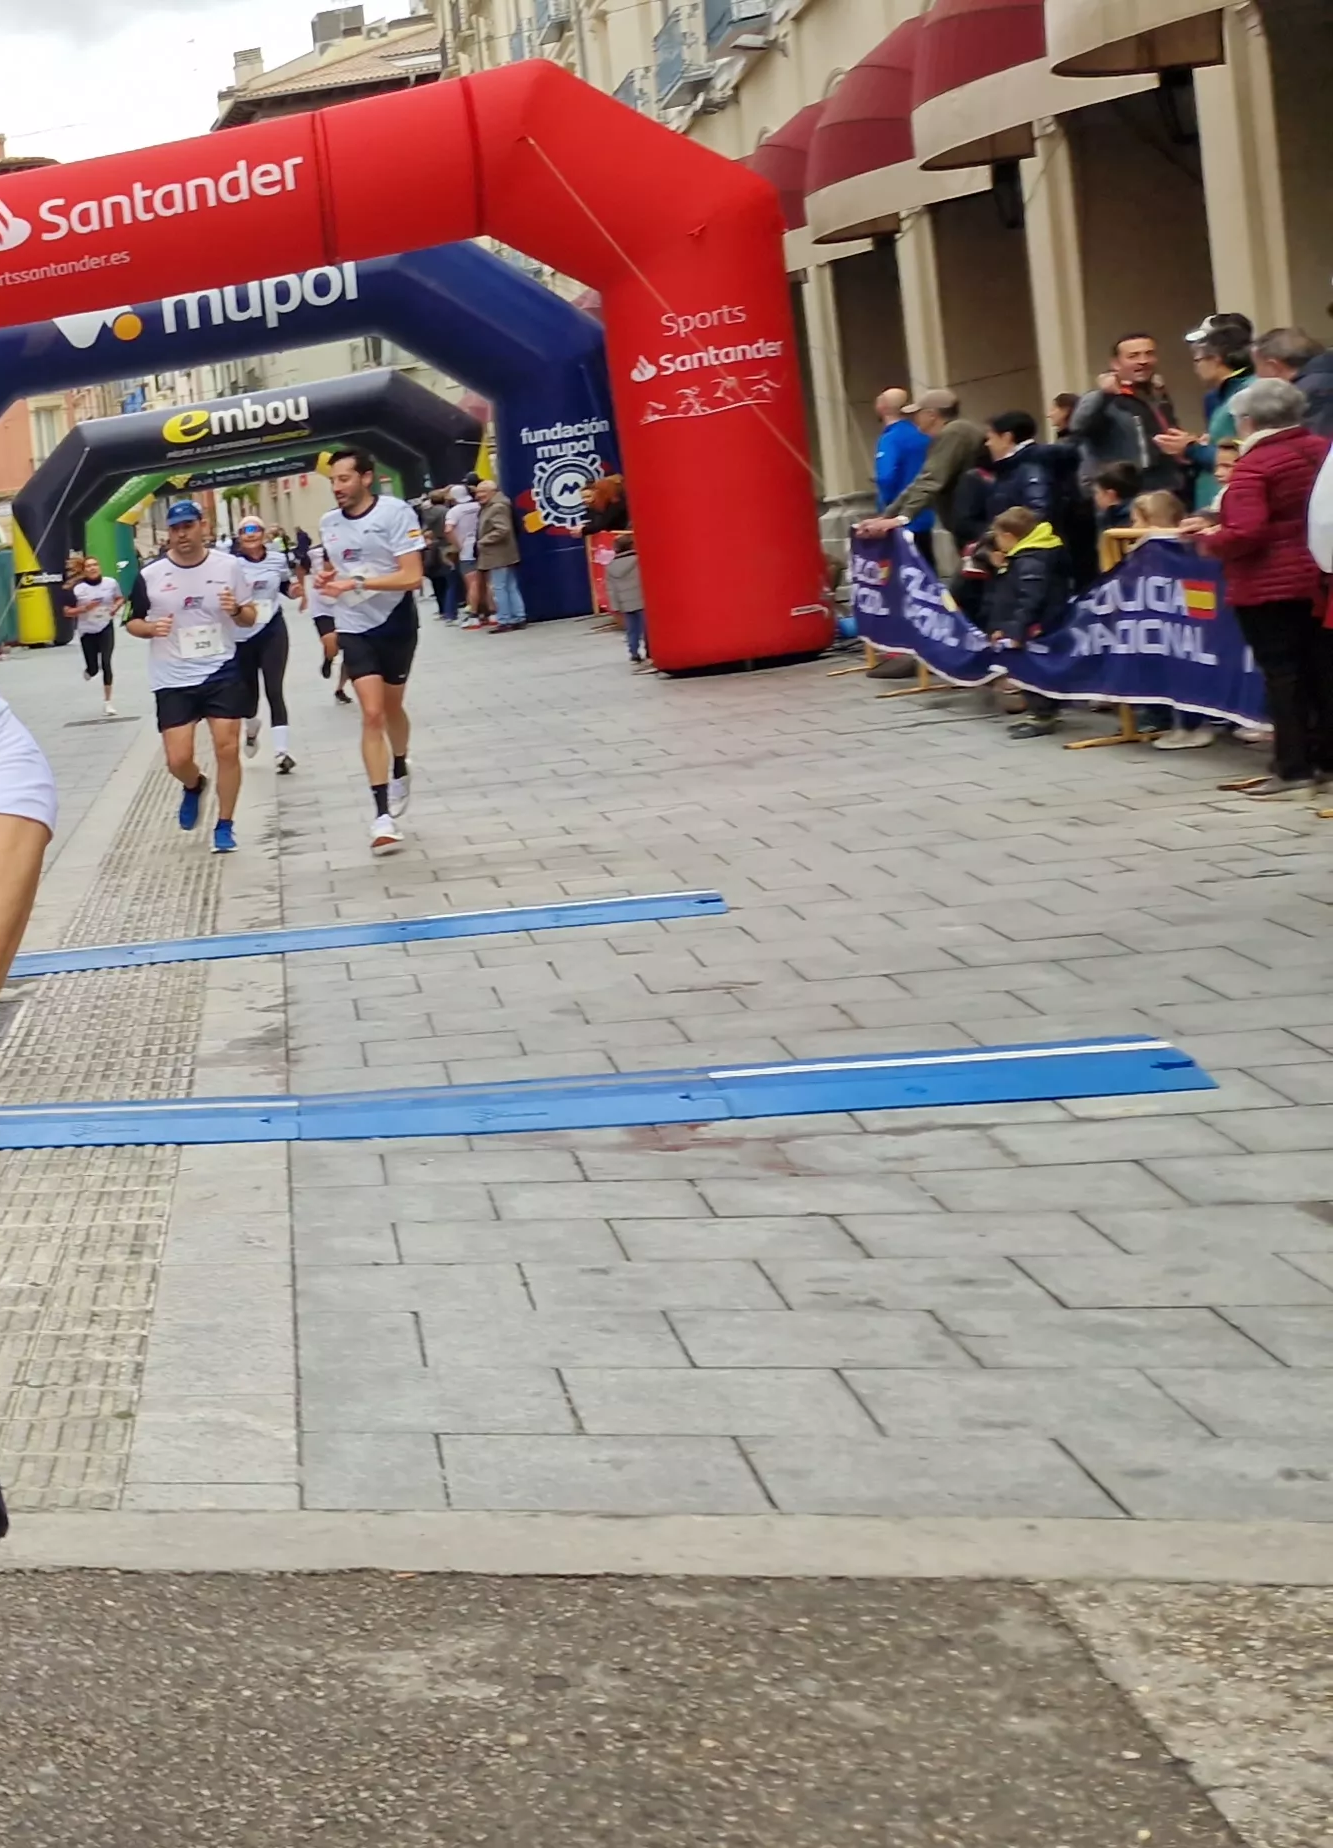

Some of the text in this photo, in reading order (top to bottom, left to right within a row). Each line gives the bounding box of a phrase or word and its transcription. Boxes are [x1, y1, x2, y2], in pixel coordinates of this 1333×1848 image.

[38, 156, 304, 242] Santander
[160, 260, 360, 334] mupol
[660, 303, 747, 338] Sports
[658, 338, 784, 377] Santander
[162, 396, 309, 444] embou
[520, 417, 610, 445] fundación
[536, 436, 595, 459] mupol
